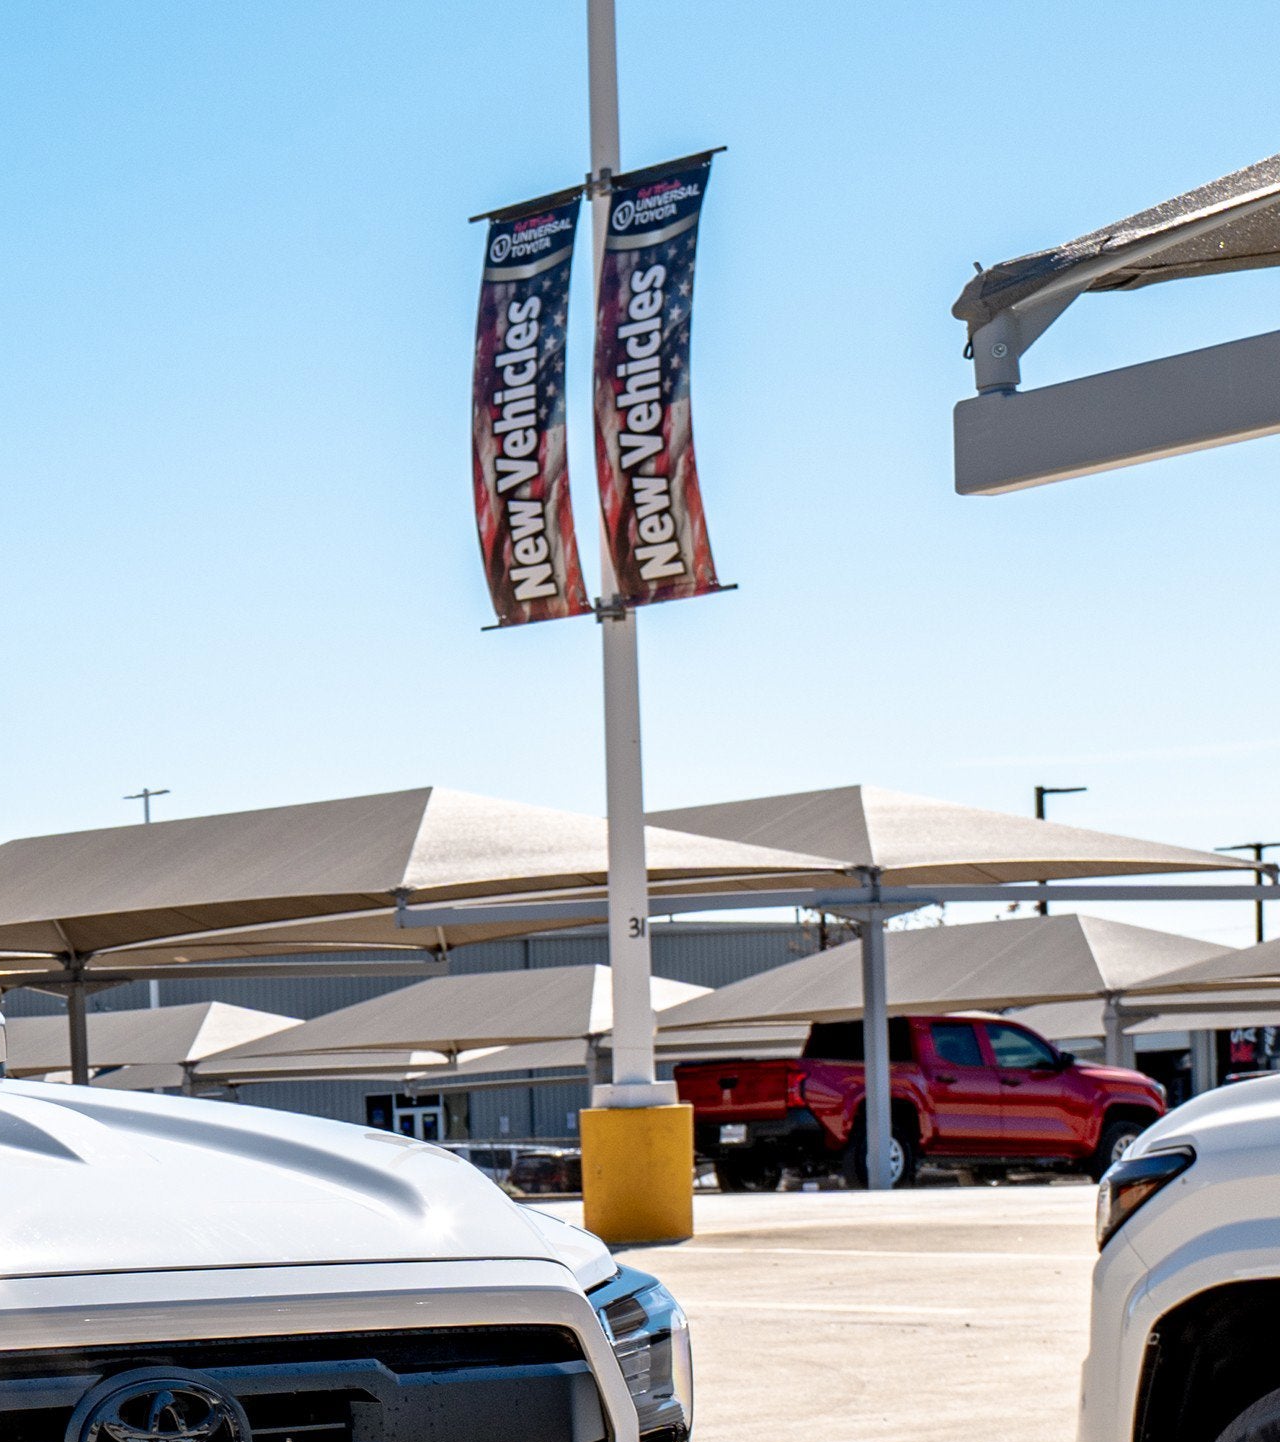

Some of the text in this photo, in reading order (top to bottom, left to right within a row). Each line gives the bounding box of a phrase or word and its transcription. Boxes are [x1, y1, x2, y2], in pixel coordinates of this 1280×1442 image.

[635, 183, 700, 212] UNIVERSAL
[634, 203, 677, 225] TOYOTA
[512, 217, 572, 244] UNIVERSAL
[511, 236, 552, 258] TOYOTA
[617, 264, 687, 582] New Vehicles
[494, 294, 558, 601] New Vehicles
[628, 917, 645, 938] 31
